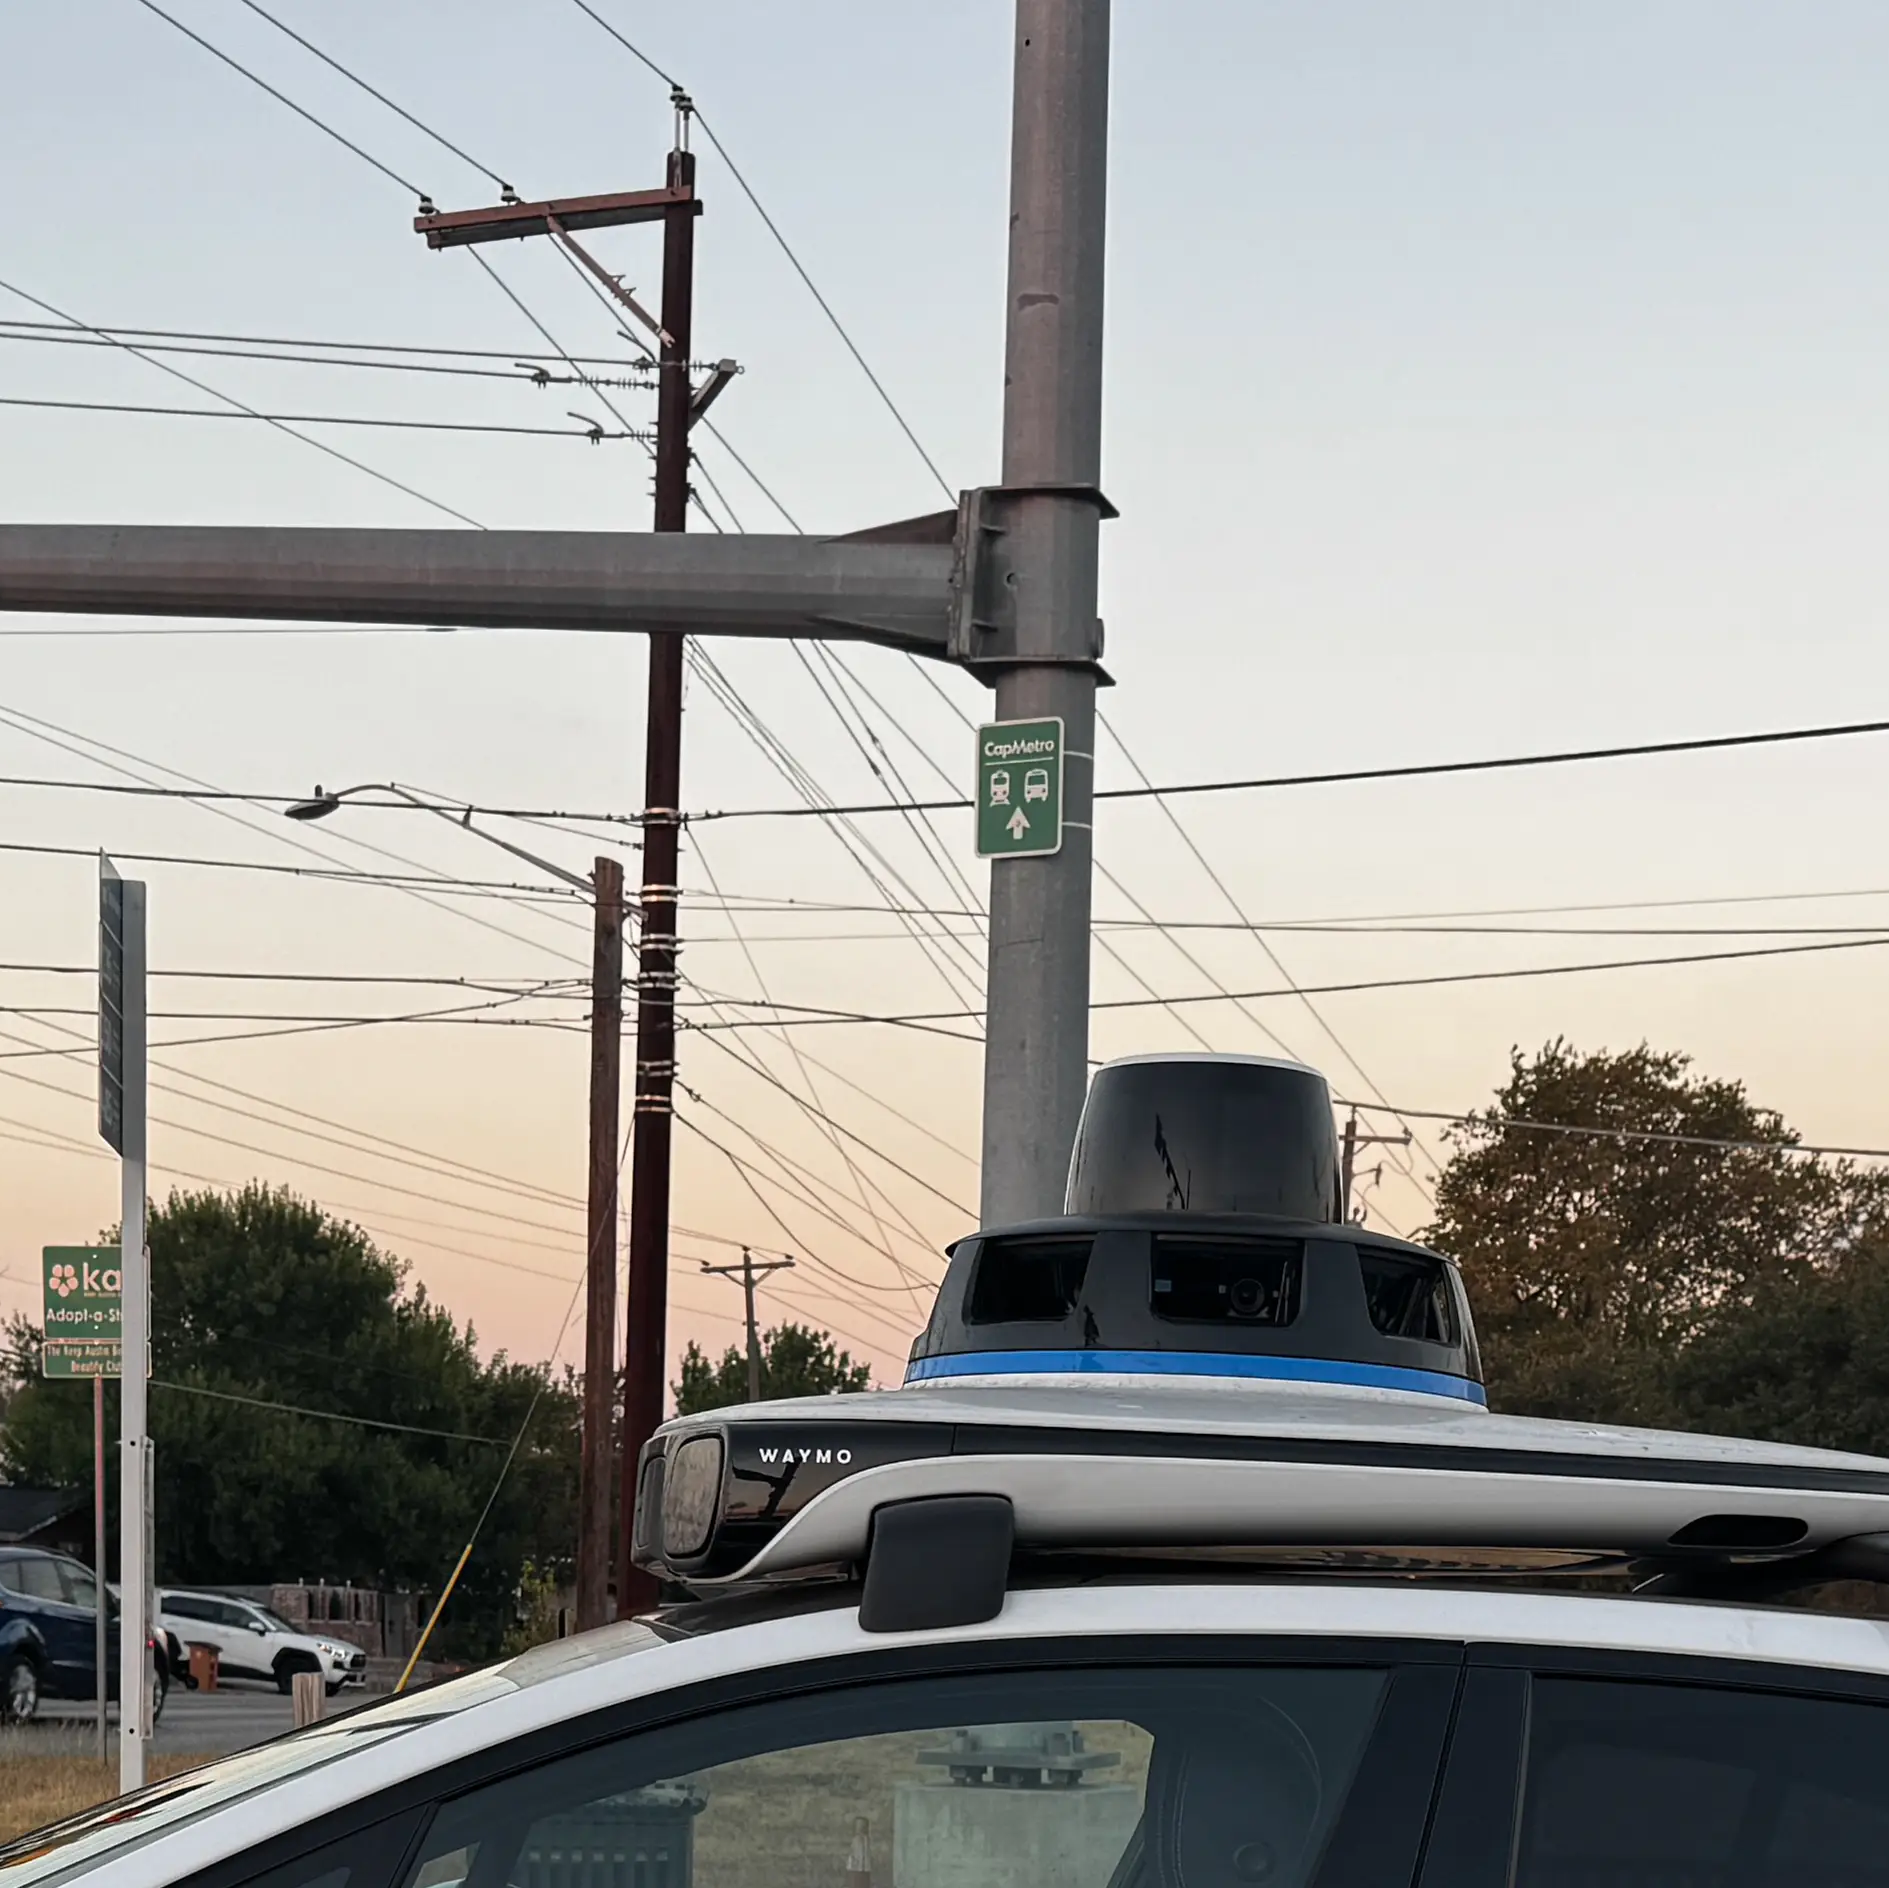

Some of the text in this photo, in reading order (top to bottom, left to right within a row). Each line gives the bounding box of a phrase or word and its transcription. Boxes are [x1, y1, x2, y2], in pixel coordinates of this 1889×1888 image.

[984, 738, 1055, 759] CapMetro
[82, 1261, 122, 1292] ka
[46, 1307, 122, 1325] Adopt-a-St
[758, 1447, 852, 1465] WAYMO
